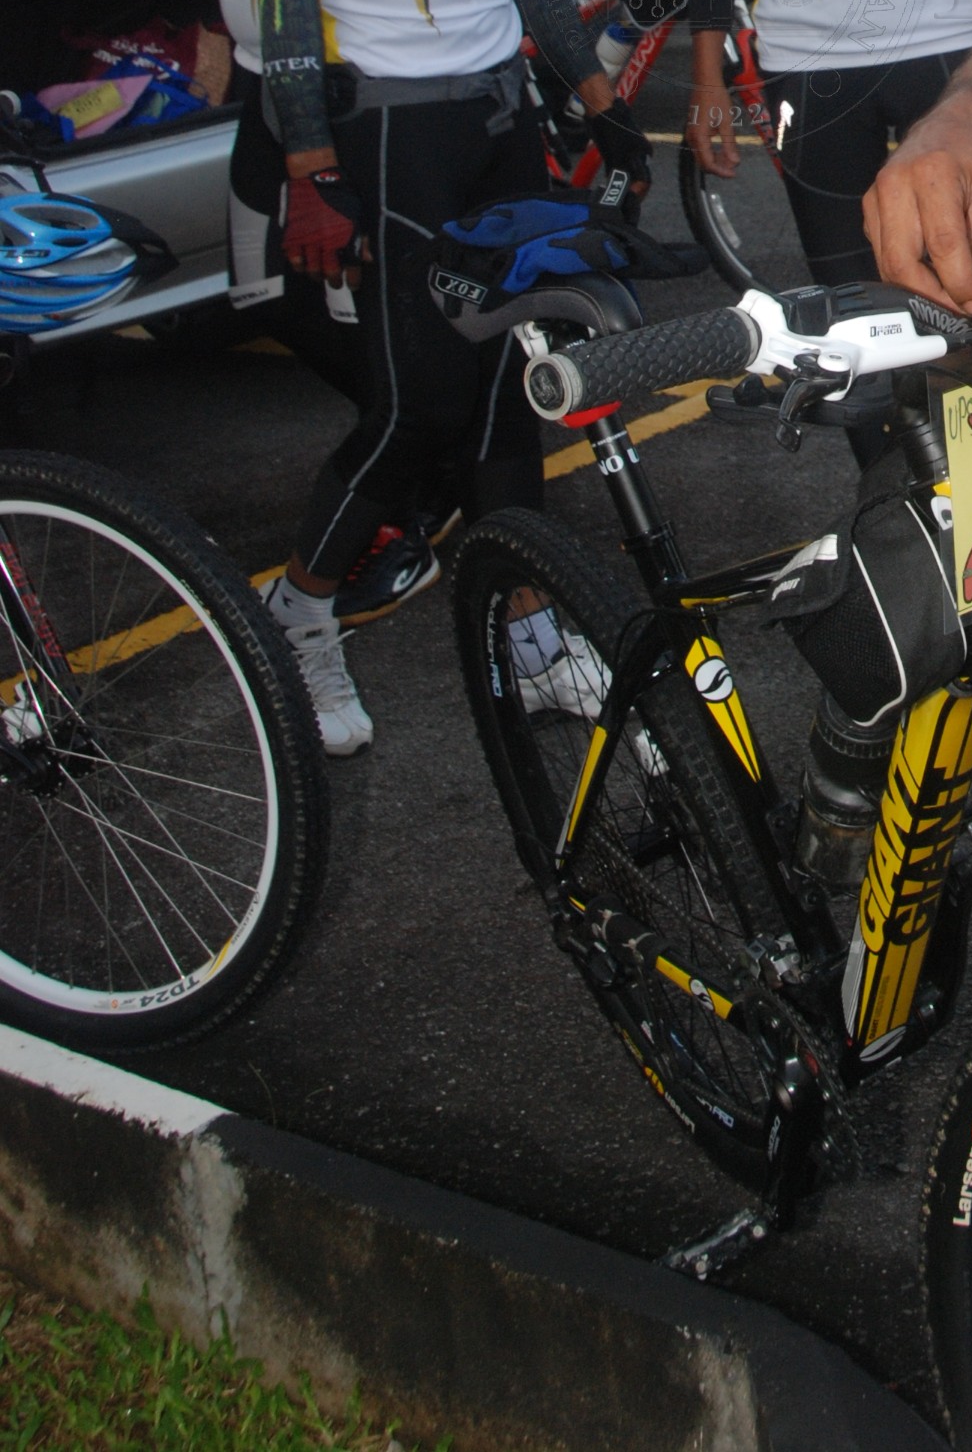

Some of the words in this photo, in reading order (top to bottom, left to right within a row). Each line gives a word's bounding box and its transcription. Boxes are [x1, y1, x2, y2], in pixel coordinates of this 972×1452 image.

[604, 180, 624, 202] FOX
[445, 279, 481, 300] FOX
[860, 745, 922, 954] GIANT
[139, 974, 200, 1009] TD24
